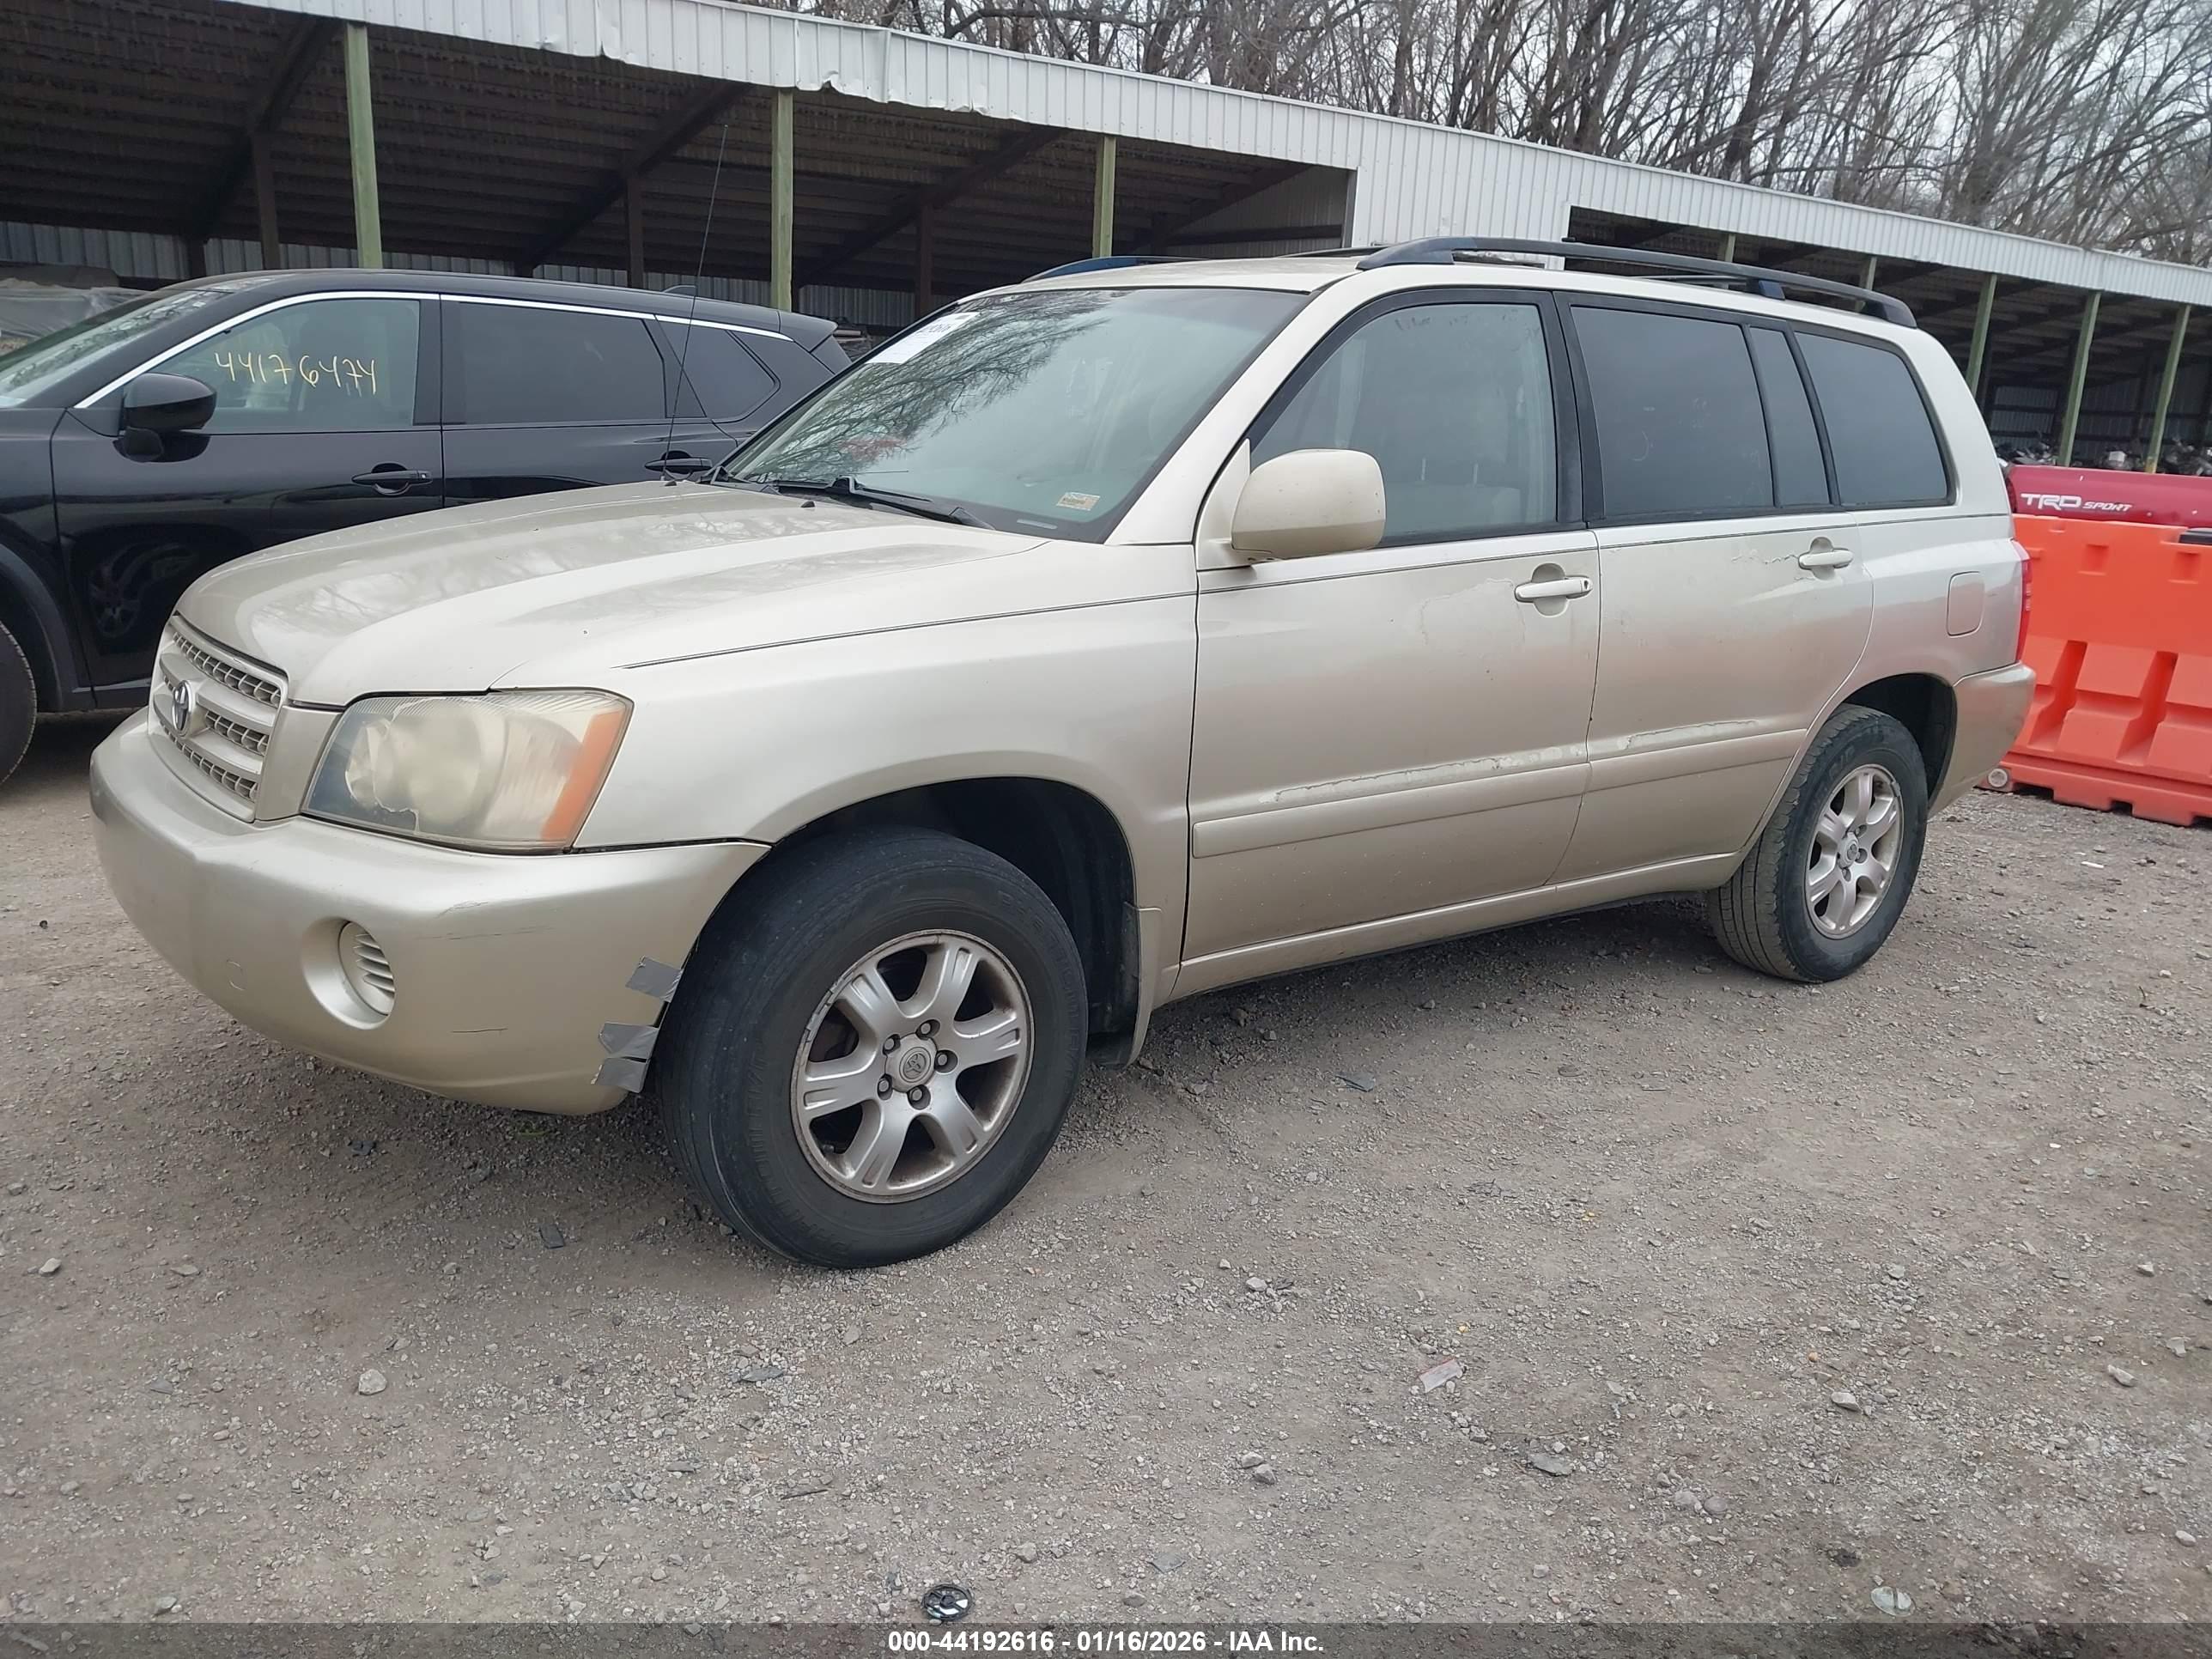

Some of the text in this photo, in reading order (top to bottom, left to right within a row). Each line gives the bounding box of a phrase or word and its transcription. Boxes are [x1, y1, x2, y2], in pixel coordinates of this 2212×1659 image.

[215, 351, 377, 395] 44176474
[2021, 493, 2133, 512] TRD SPORT
